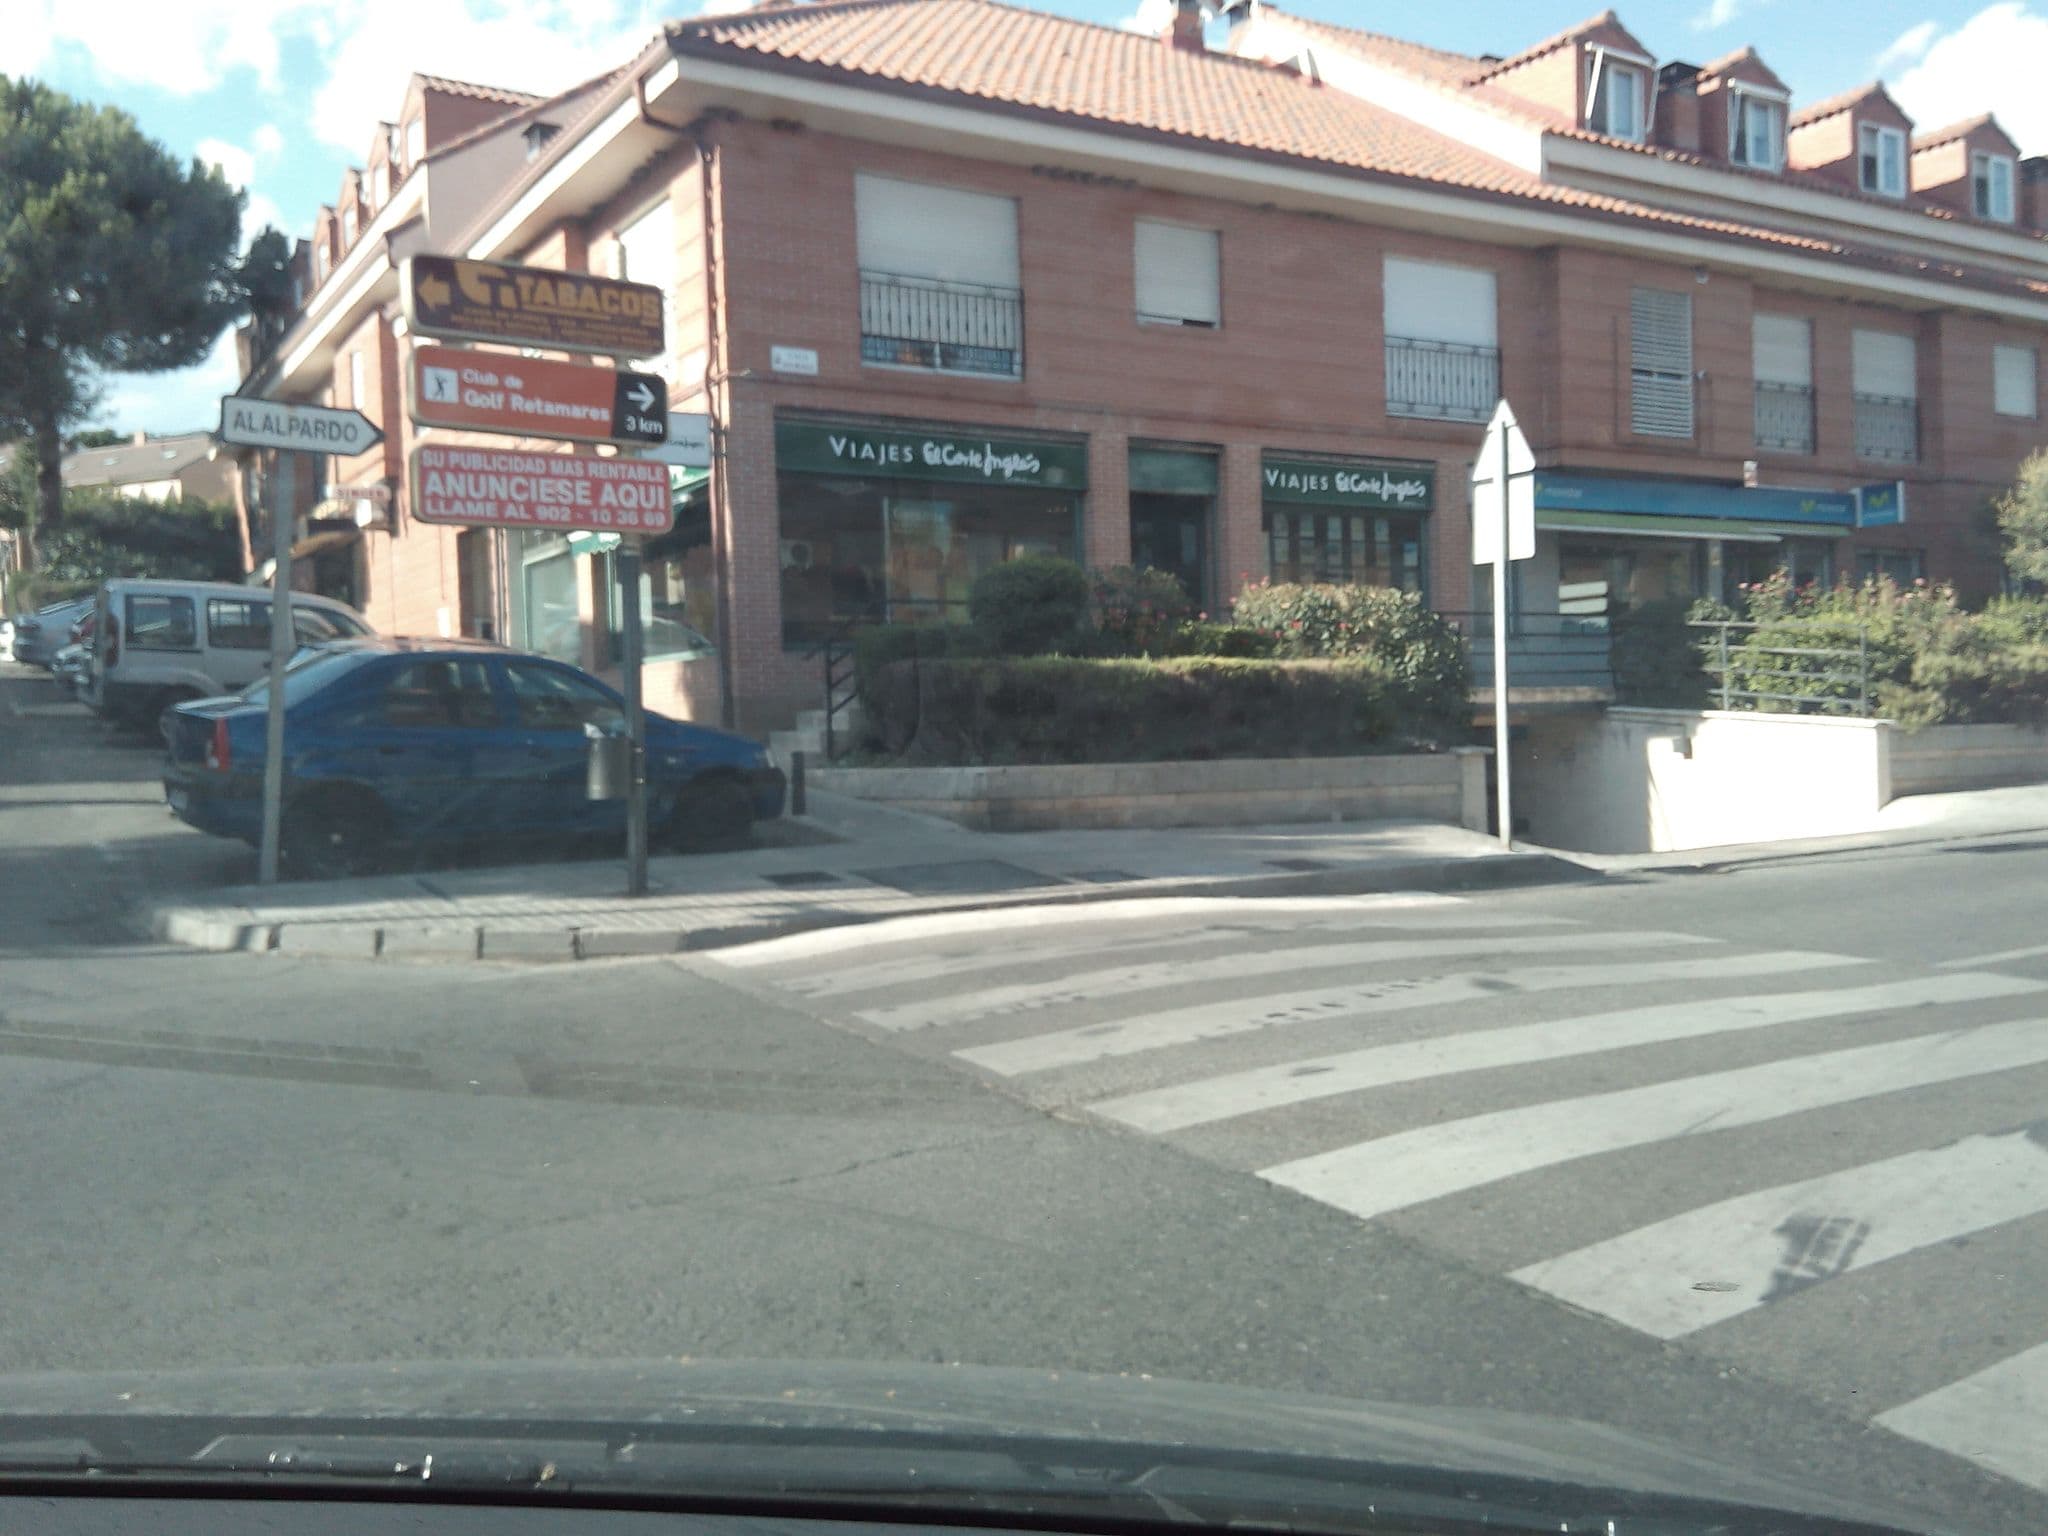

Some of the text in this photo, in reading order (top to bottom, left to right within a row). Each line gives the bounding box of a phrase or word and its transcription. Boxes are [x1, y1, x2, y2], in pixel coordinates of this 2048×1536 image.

[514, 275, 661, 318] TABACOS
[463, 368, 523, 389] Club de
[464, 389, 610, 422] Golf Retamares
[233, 410, 359, 442] ALALPARDO
[625, 415, 663, 434] 3 km
[829, 435, 913, 465] VIAJES
[422, 450, 664, 482] SU PUBLICIDAD MAS RENTABLE
[1265, 468, 1328, 493] VIAJES
[424, 472, 665, 510] ANUNCIESE AQUI
[425, 500, 498, 517] LLAME
[504, 503, 531, 520] AL
[537, 505, 571, 522] 902
[590, 508, 611, 524] 10
